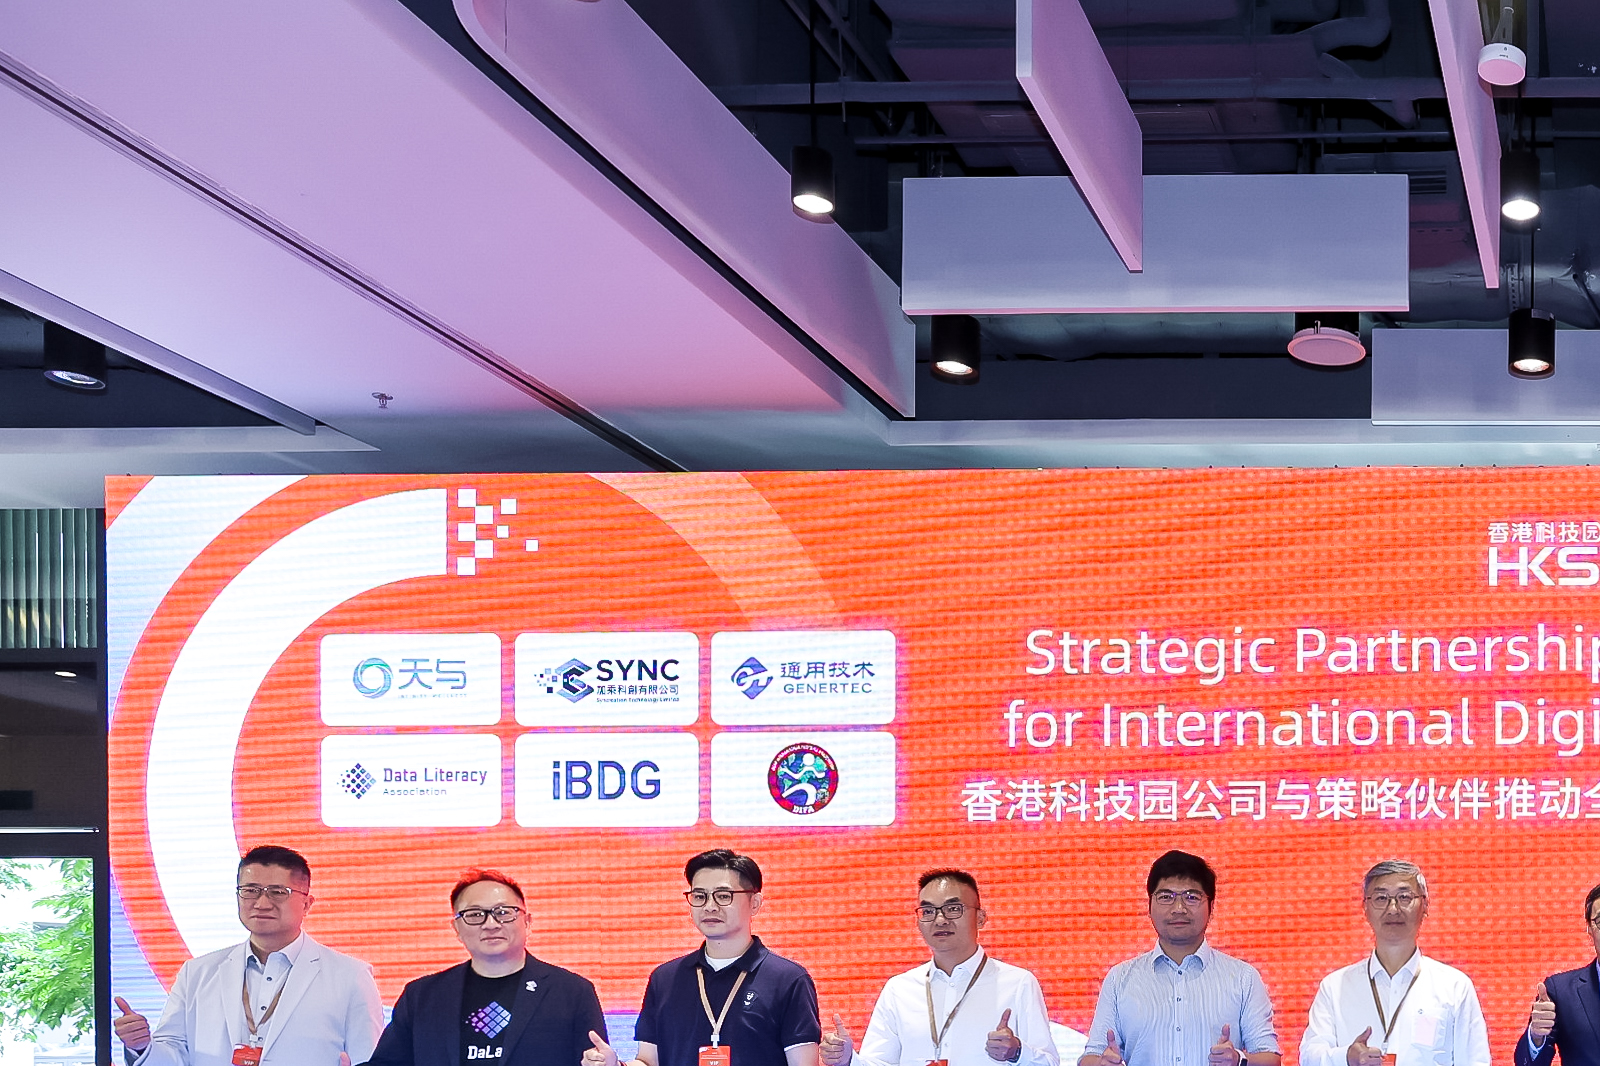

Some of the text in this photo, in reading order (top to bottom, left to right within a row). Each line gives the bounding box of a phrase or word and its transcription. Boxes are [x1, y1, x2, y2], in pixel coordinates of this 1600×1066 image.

[1025, 626, 1277, 685] Strategic
[398, 658, 467, 690] 天与
[596, 659, 680, 681] SYNC
[783, 683, 873, 694] GENERTEC
[1003, 699, 1082, 748] for
[1103, 698, 1471, 748] International
[383, 767, 488, 786] Data Literacy
[552, 760, 661, 800] iBDG
[382, 787, 447, 796] Association
[467, 1045, 503, 1060] DaLa
